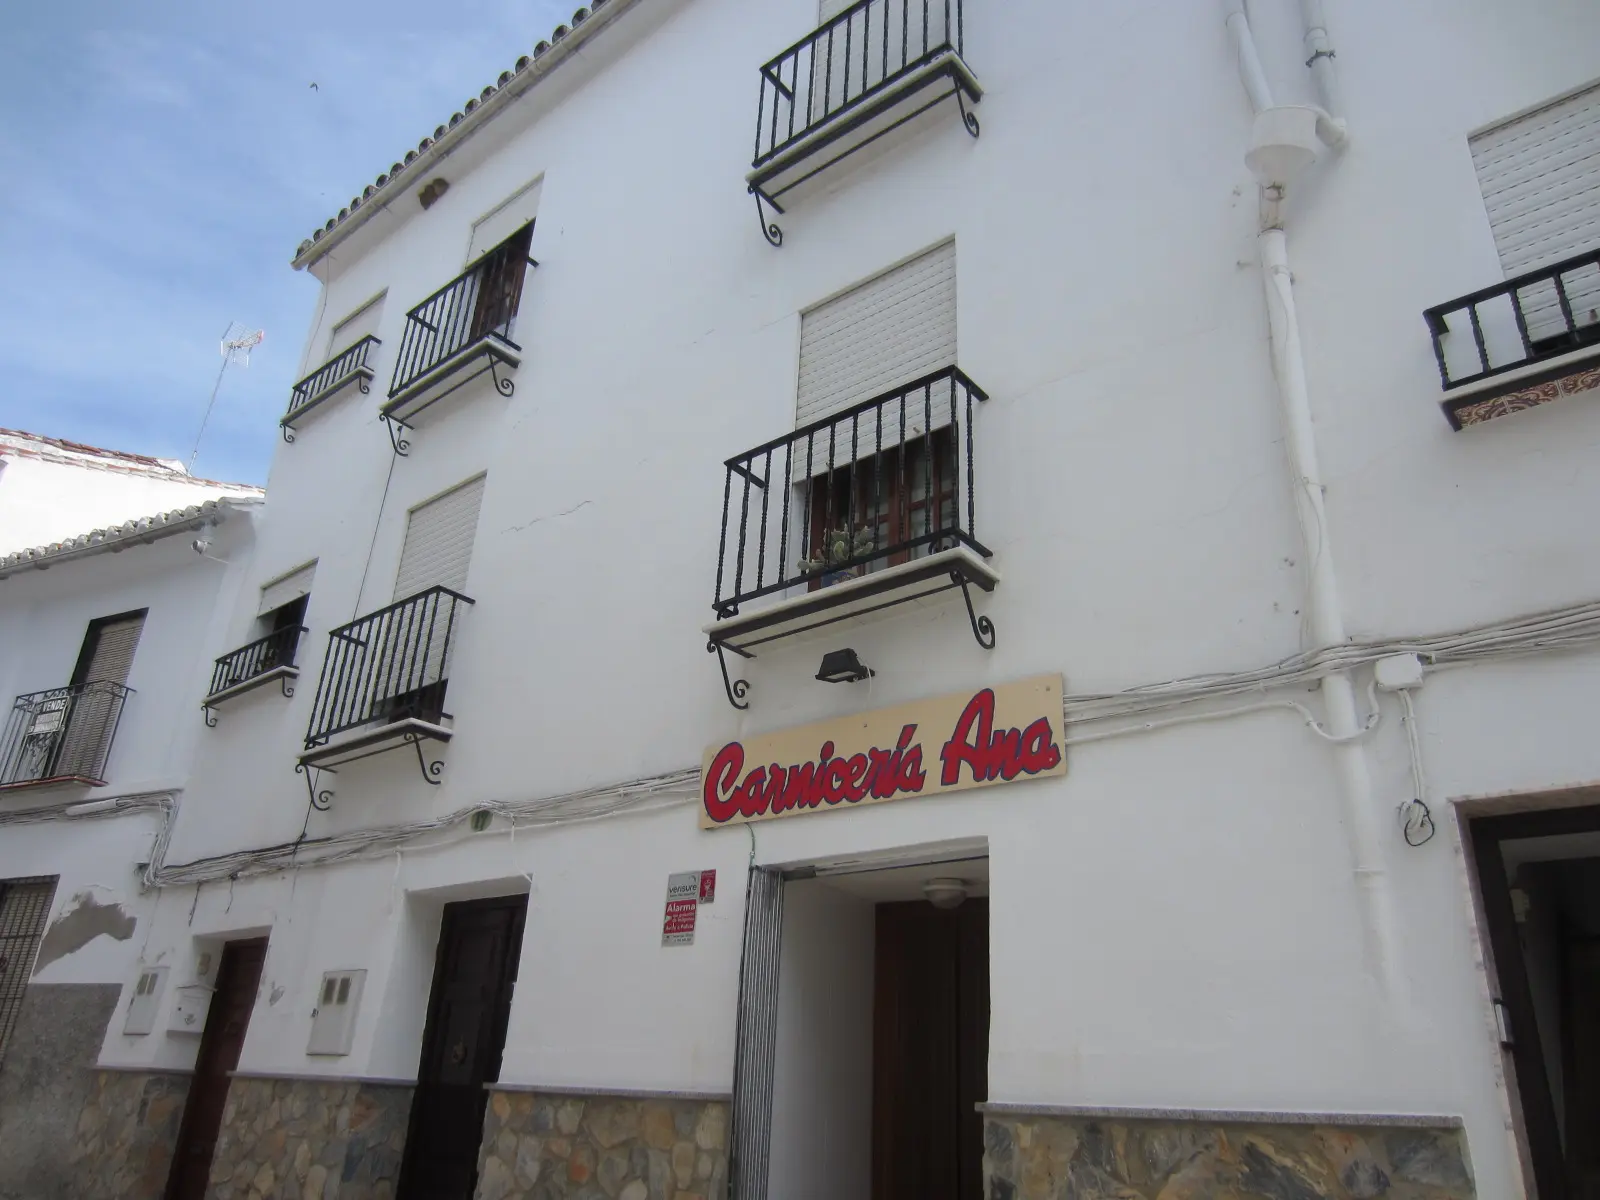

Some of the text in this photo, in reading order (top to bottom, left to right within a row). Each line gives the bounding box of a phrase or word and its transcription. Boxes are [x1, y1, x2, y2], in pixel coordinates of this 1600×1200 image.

[43, 699, 66, 712] VENDE
[704, 688, 1062, 822] Carnicería Ana
[667, 903, 696, 913] Alarma
